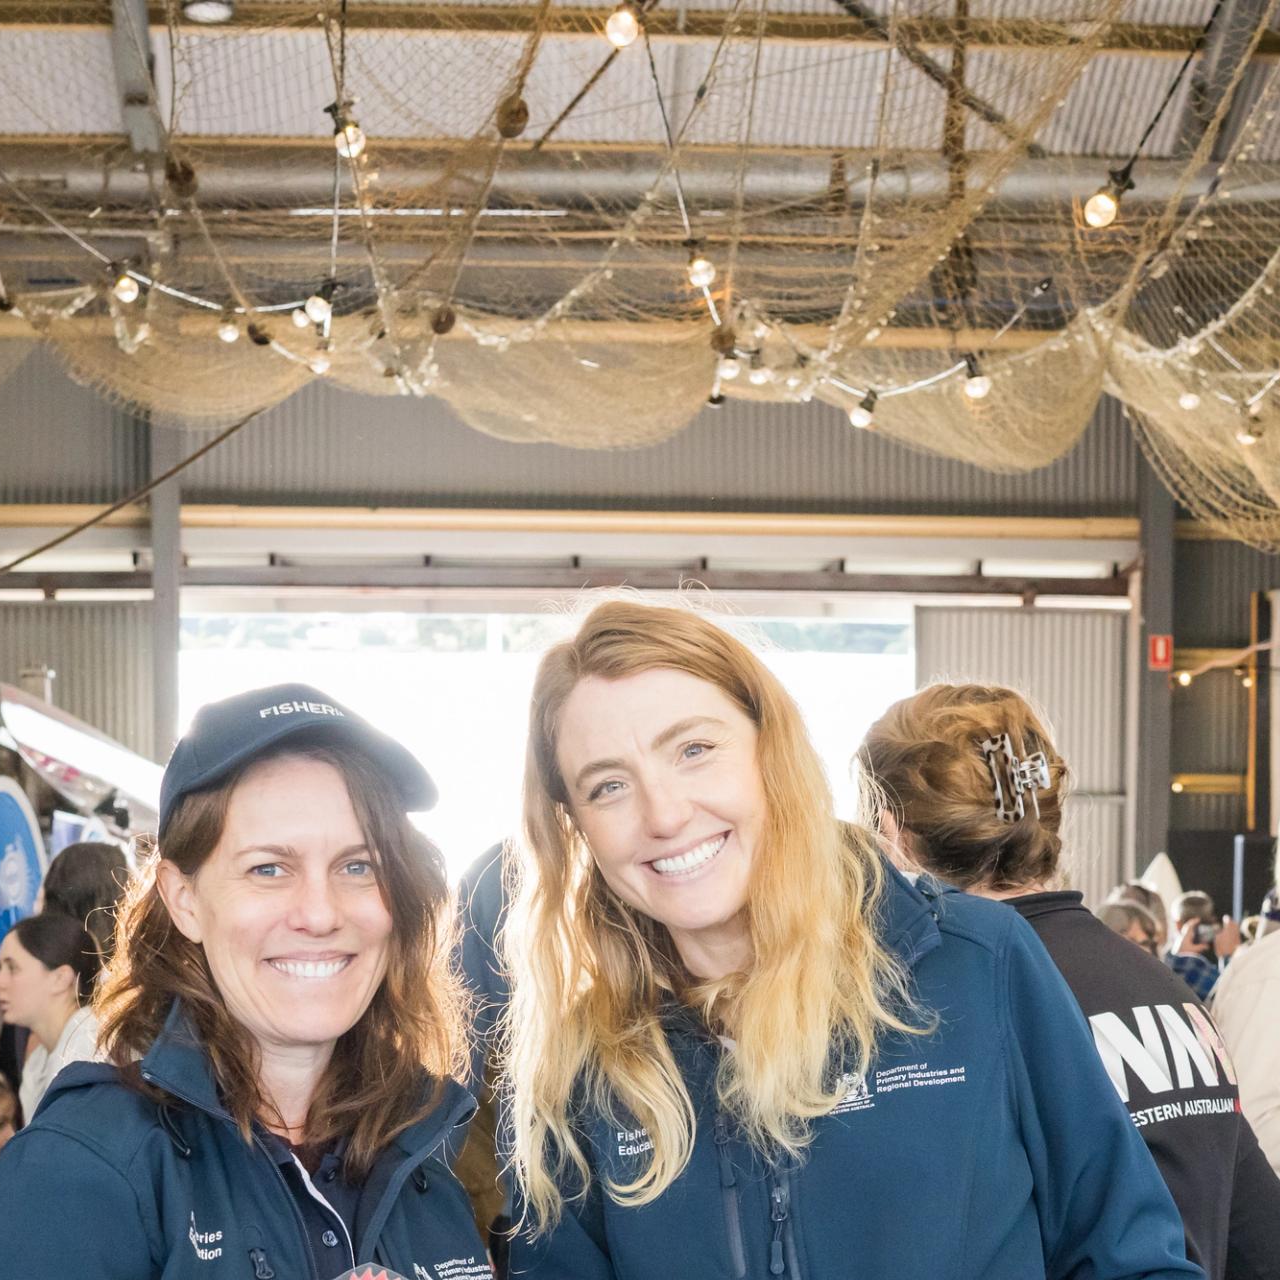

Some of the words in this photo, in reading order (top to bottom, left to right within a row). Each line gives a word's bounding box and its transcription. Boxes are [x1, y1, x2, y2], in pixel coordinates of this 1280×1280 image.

[876, 1064, 918, 1079] Department
[876, 1073, 907, 1087] Primary
[908, 1069, 948, 1079] Industries
[949, 1066, 965, 1076] and
[876, 1080, 912, 1093] Regional
[913, 1075, 966, 1088] Development
[1129, 1102, 1184, 1128] ESTERN
[1184, 1098, 1234, 1117] AUSTRALIAN
[617, 1128, 647, 1142] Fishe
